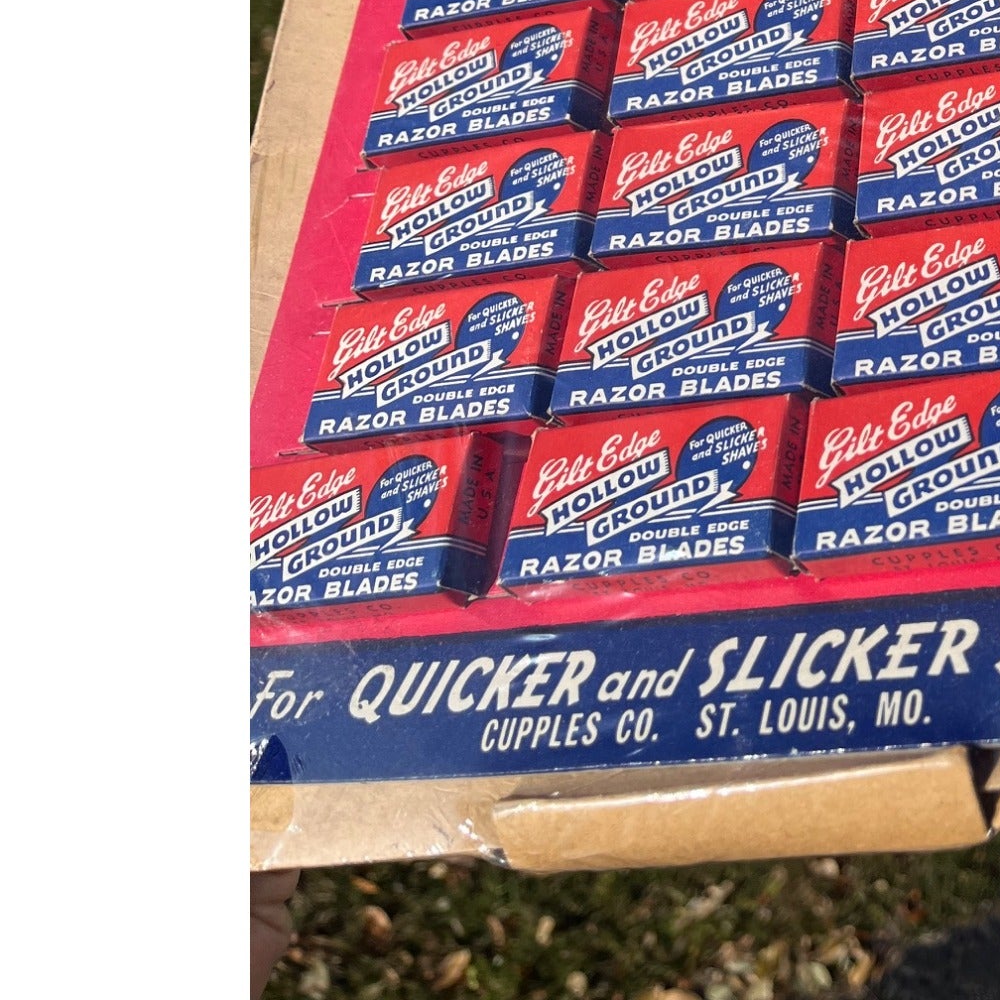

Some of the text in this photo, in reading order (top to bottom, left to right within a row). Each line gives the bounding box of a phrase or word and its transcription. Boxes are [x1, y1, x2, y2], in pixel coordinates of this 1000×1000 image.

[511, 27, 556, 50] For QUICKER
[512, 28, 570, 58] and SLICKER
[535, 36, 572, 59] SHAVES
[384, 35, 490, 105] Gilt Edge
[403, 56, 488, 109] HOLLOW
[434, 68, 526, 117] GROUND
[461, 94, 555, 118] DOUBLE EDGE
[376, 106, 551, 148] RAZOR BLADES
[874, 84, 997, 164] Gilt Edge
[899, 108, 1000, 169] HOLLOW
[877, 185, 977, 214] RAZOR
[689, 422, 747, 451] For QUICKER
[691, 425, 765, 462] and SLICKER
[721, 437, 768, 466] SHAVES
[526, 428, 661, 517] Gilt Edge
[552, 458, 660, 524] HOLLOW
[593, 477, 711, 539] GROUND
[628, 518, 750, 543] DOUBLE EDGE
[519, 534, 745, 578] RAZOR BLADES
[250, 670, 325, 720] For
[349, 649, 596, 724] QUICKER
[599, 648, 694, 700] and
[698, 618, 980, 697] SLICKER
[480, 689, 931, 752] CUPPLES CO. ST. LOUIS, MO.
